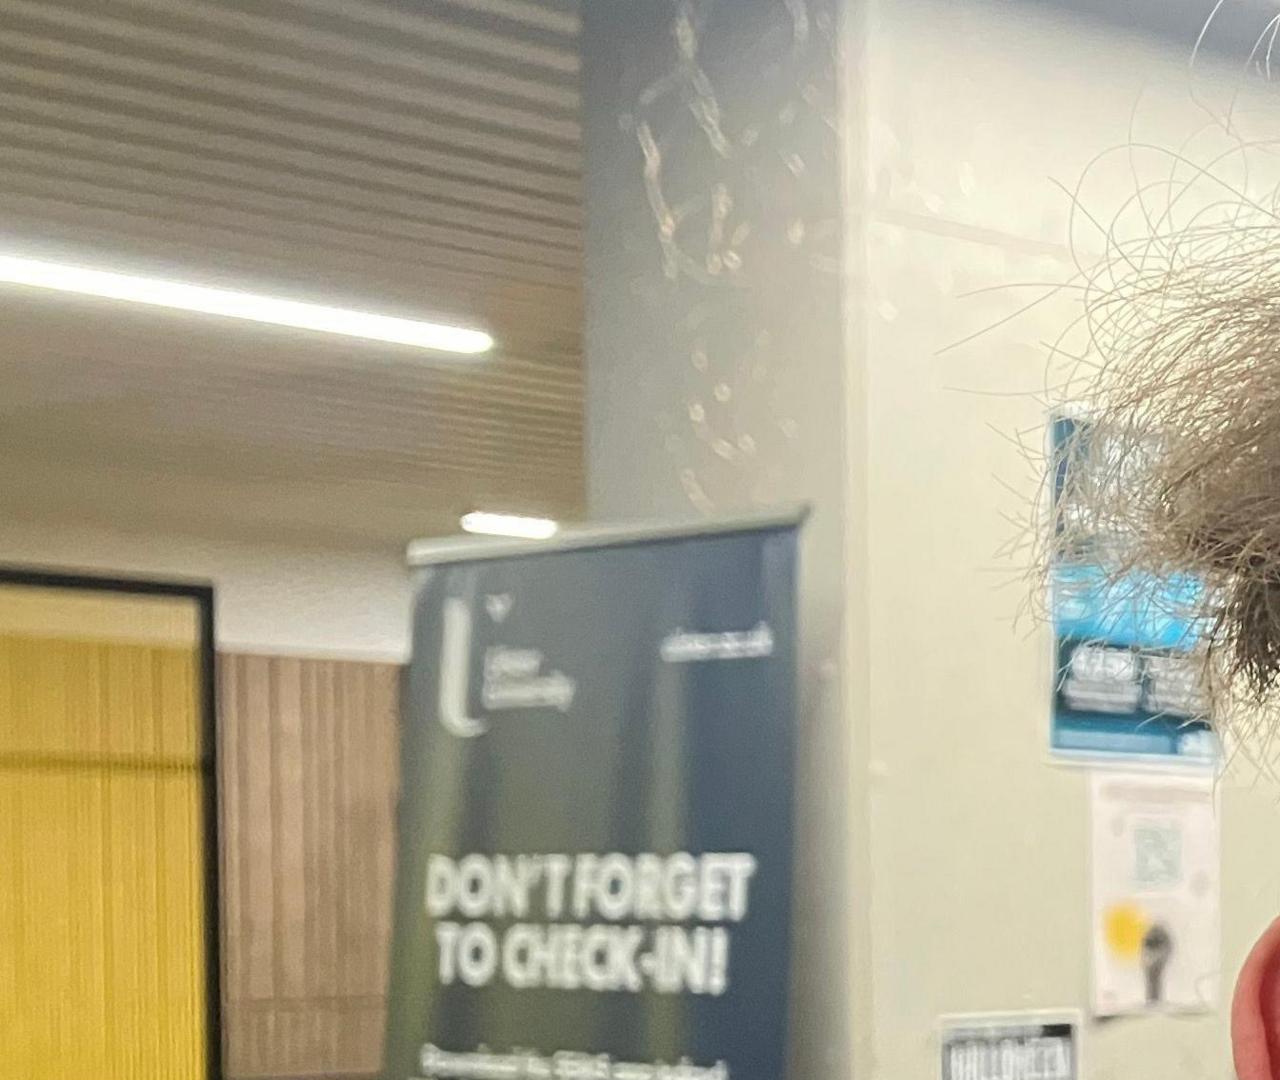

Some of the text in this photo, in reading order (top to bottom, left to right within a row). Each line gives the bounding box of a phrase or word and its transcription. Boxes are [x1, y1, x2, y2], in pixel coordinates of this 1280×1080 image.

[425, 851, 758, 922] DON'T FORGET
[435, 921, 730, 996] TO CHECK-IN!
